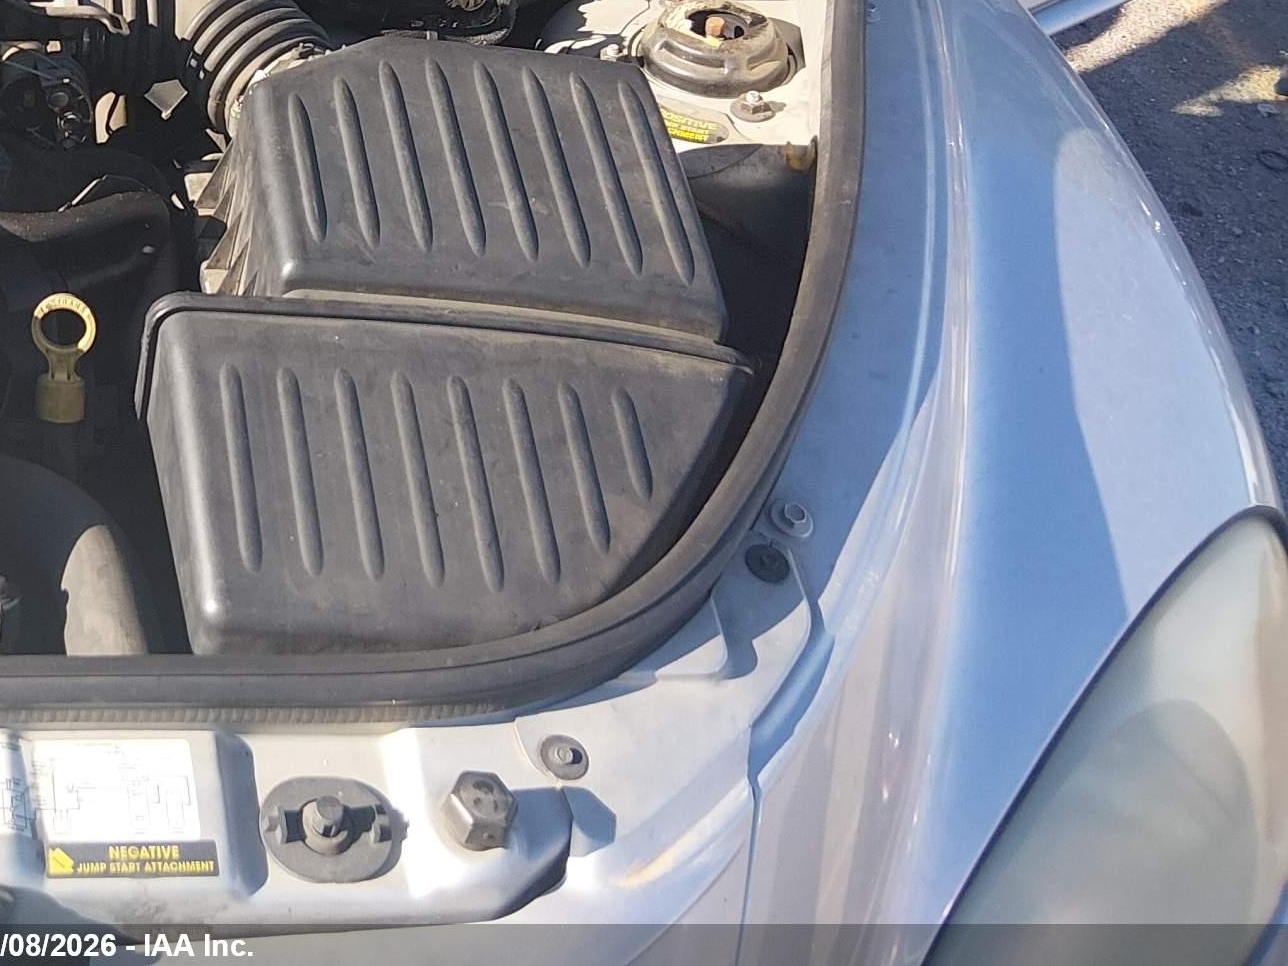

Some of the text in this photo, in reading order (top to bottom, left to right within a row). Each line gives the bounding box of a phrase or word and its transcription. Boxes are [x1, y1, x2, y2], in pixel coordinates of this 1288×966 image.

[108, 845, 180, 860] NEGATIVE
[77, 860, 215, 874] JUMP START ATTACHMENT
